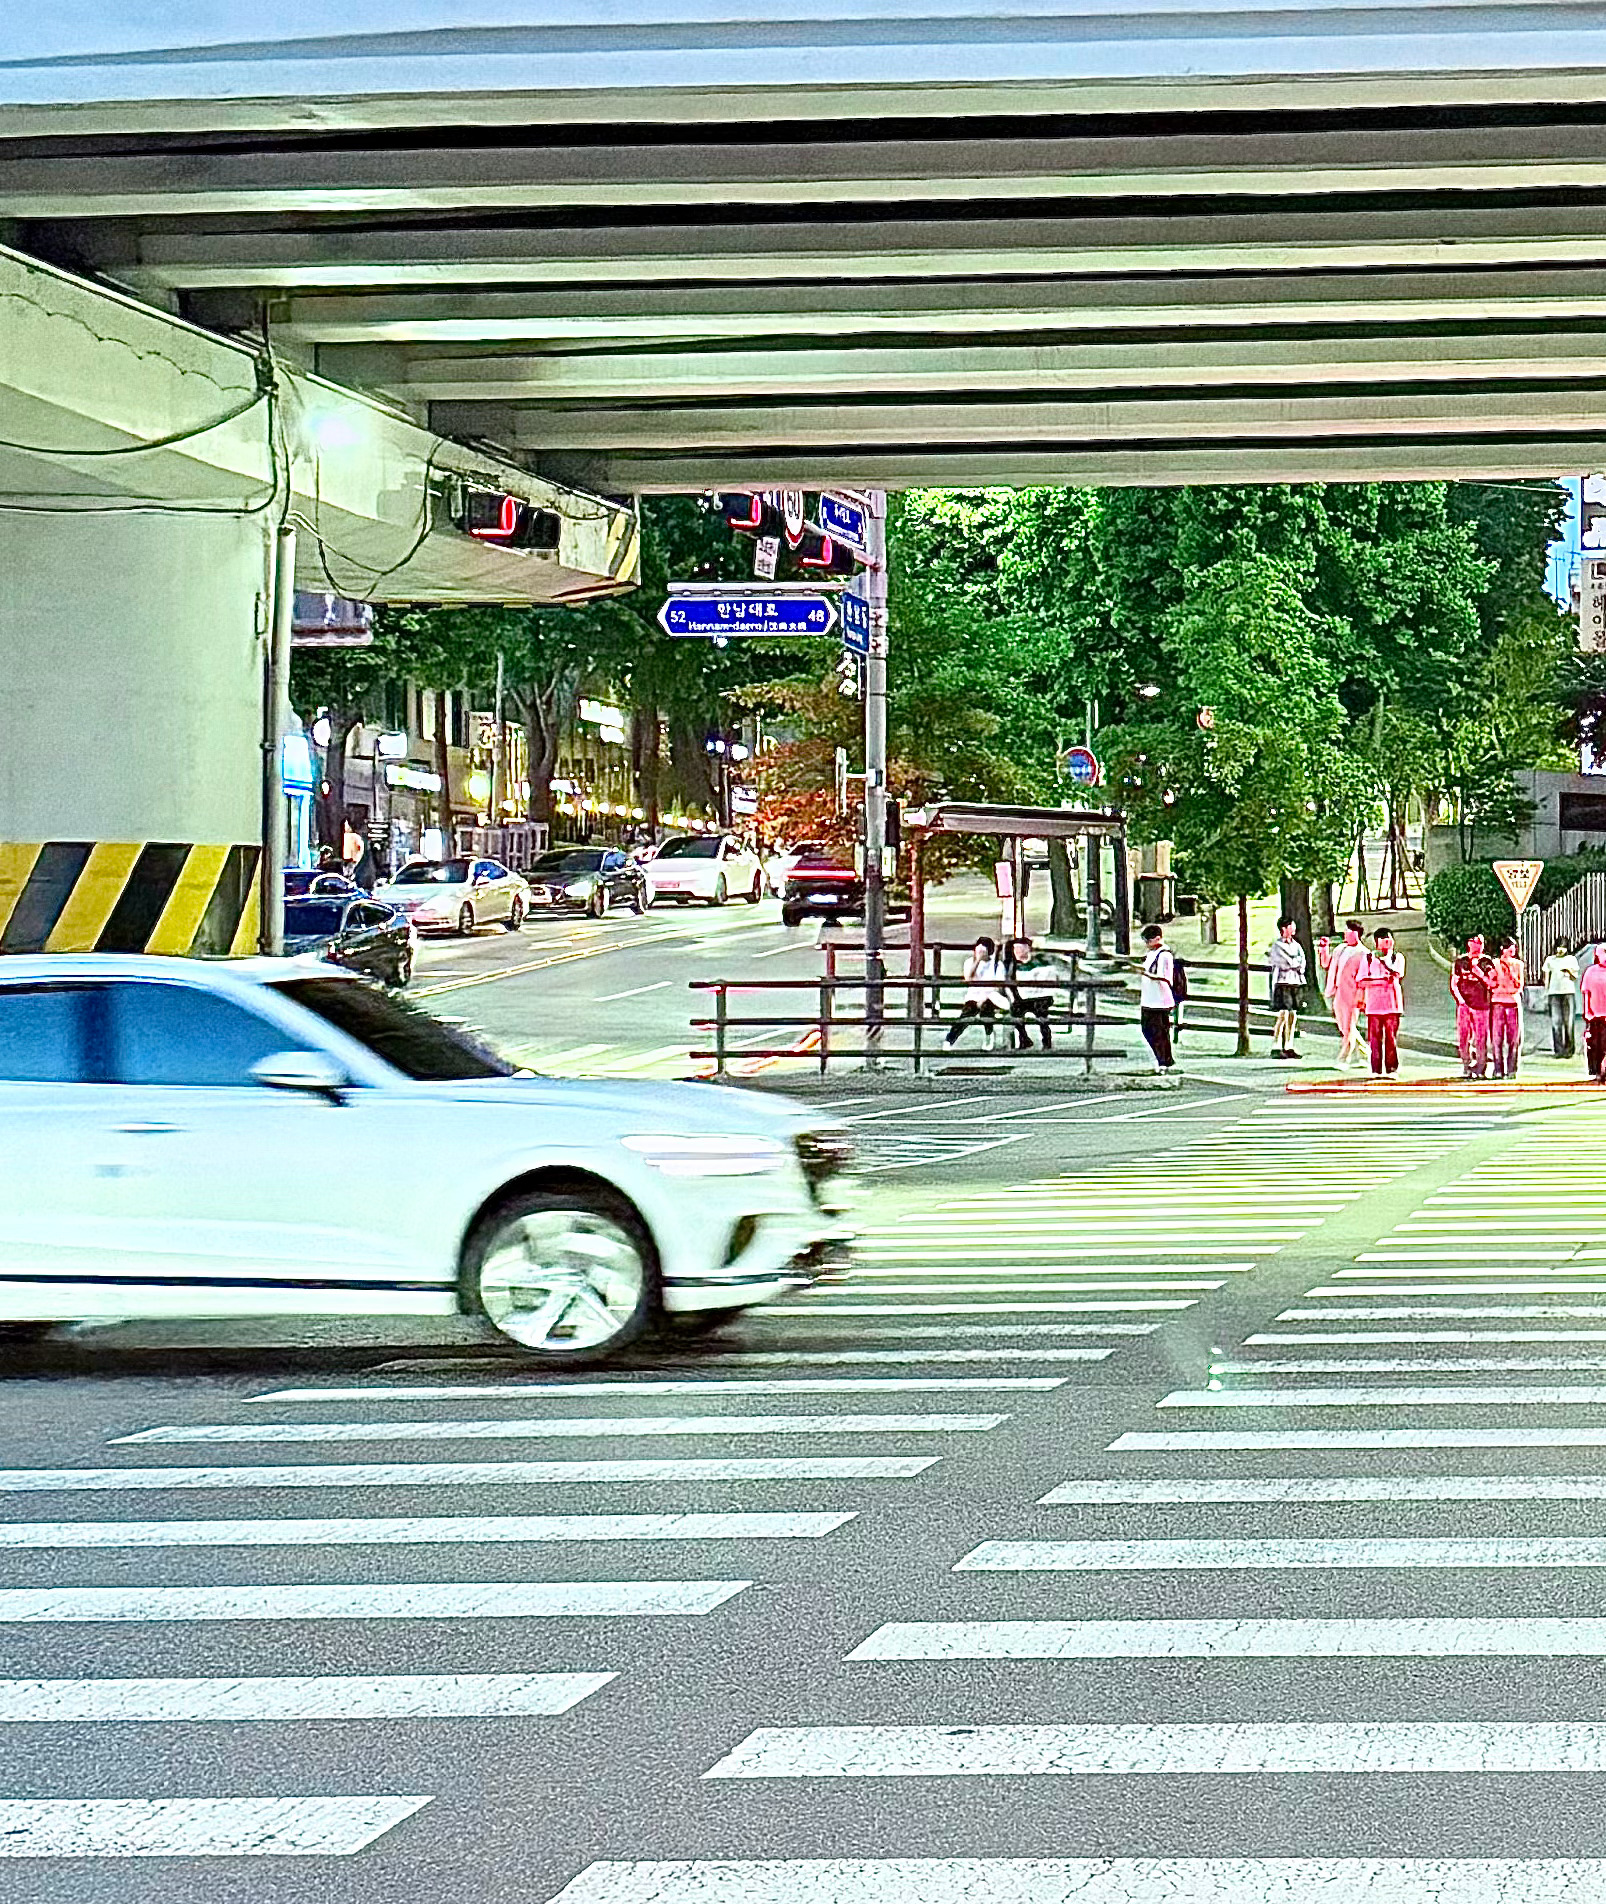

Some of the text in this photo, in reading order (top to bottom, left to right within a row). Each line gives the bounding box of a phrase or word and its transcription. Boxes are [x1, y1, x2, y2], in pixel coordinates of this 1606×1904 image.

[670, 610, 687, 623] 52
[717, 602, 778, 619] 한남대로
[807, 609, 825, 623] 48
